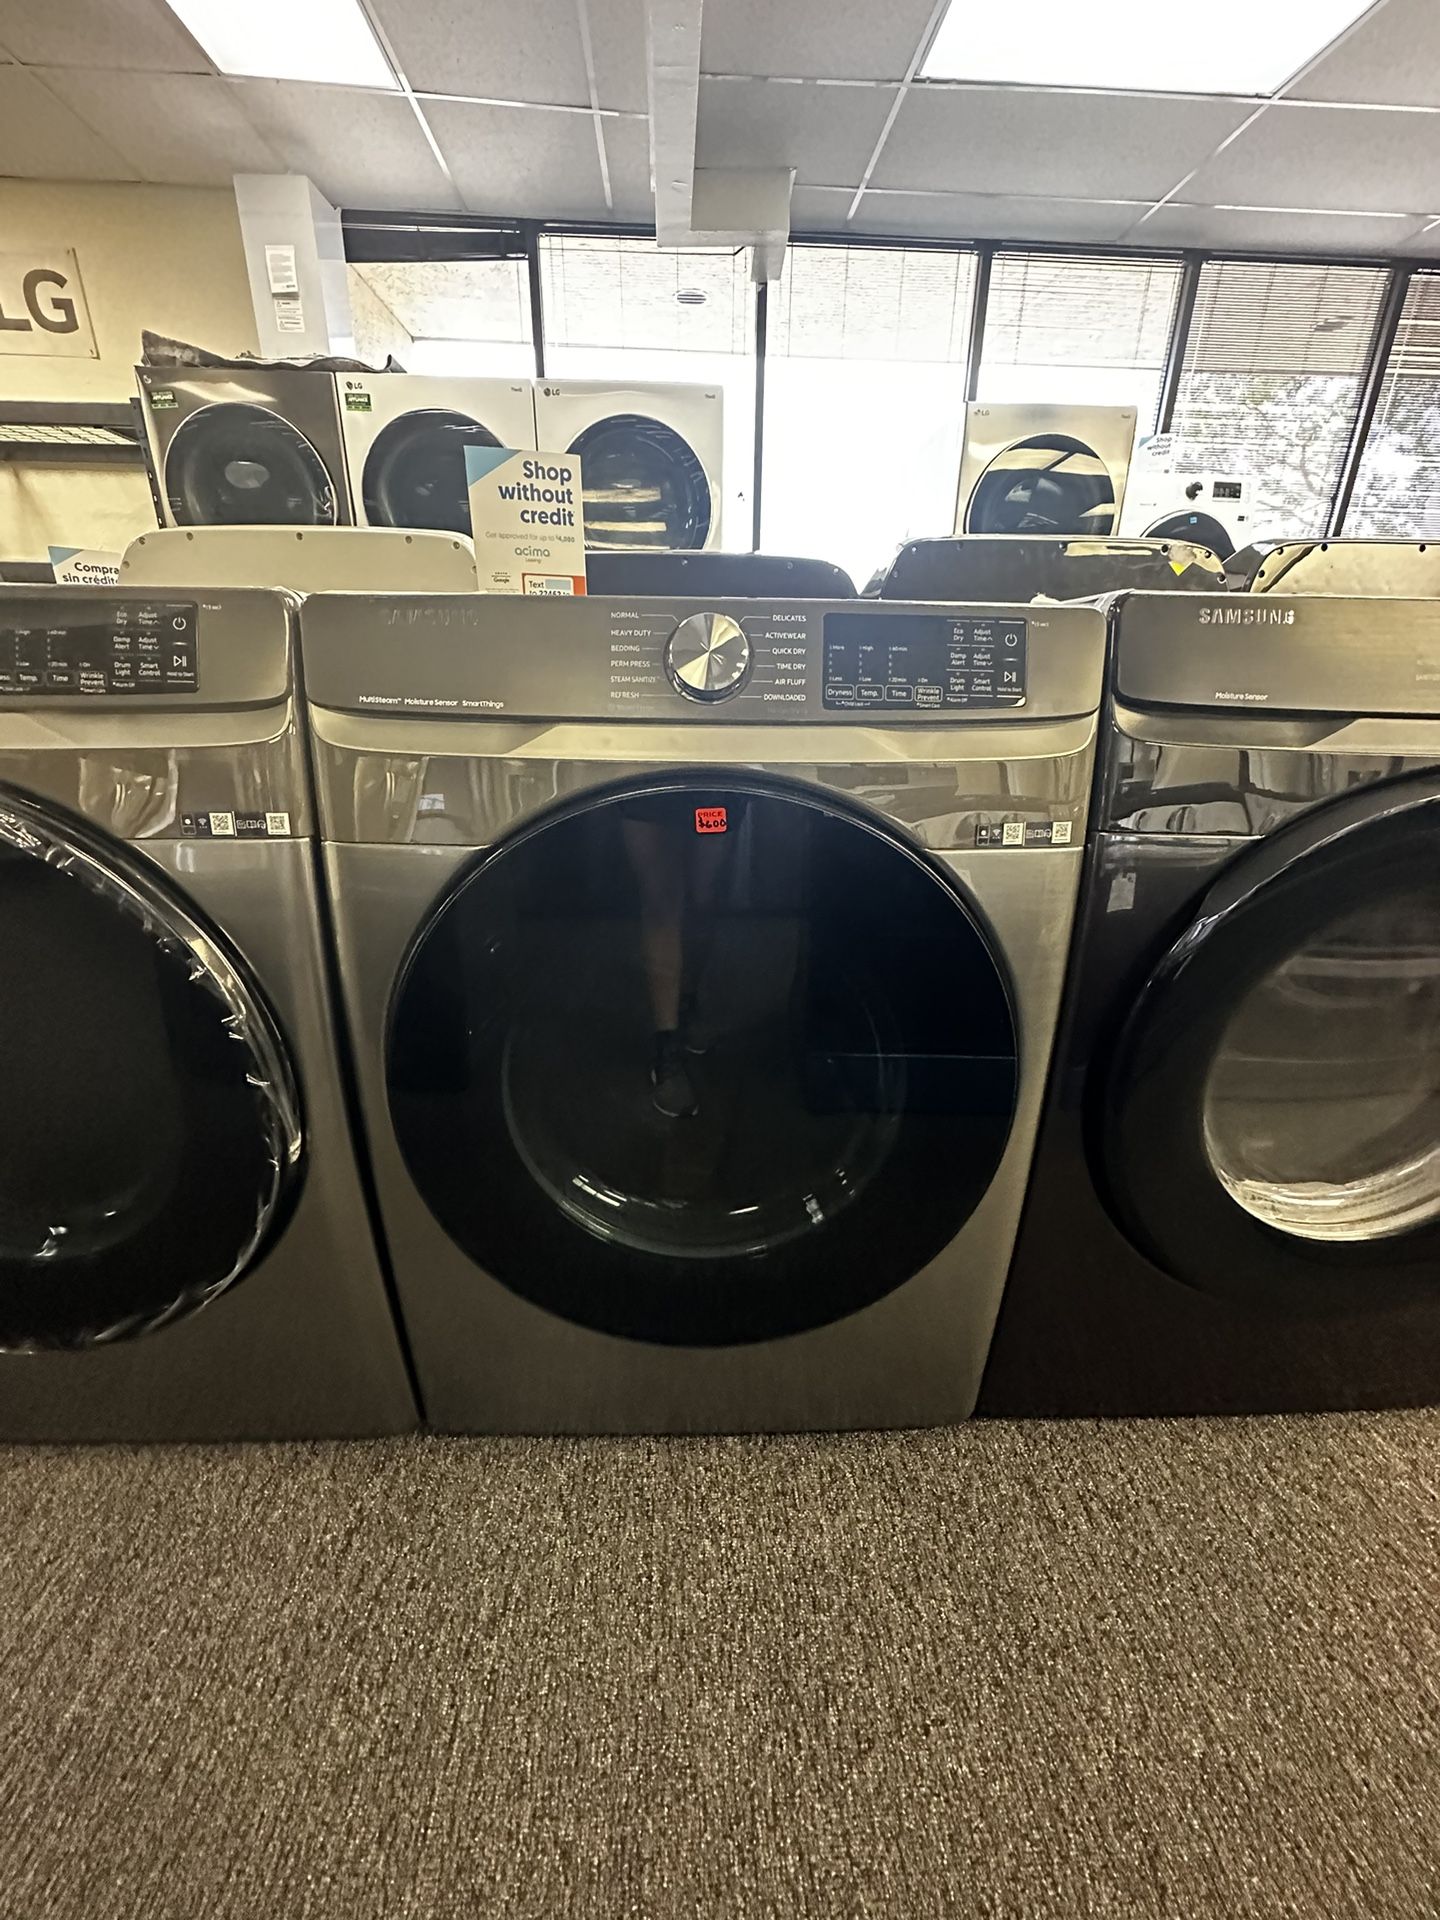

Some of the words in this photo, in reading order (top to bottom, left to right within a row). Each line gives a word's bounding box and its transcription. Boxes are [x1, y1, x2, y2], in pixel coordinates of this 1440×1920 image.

[523, 460, 572, 485] Shop
[498, 482, 573, 504] without
[520, 508, 574, 526] credit
[499, 532, 528, 540] approved
[515, 545, 550, 557] acima
[74, 562, 120, 575] Compra
[62, 572, 80, 583] sin
[529, 580, 544, 589] Text
[1199, 608, 1295, 625] SAMSUNG
[634, 629, 652, 637] DUTY
[772, 647, 792, 655] QUICK
[630, 660, 651, 668] PRESS
[610, 675, 631, 683] STEAM
[787, 678, 807, 686] FLUFF
[828, 688, 853, 697] Dryness
[860, 689, 879, 698] Temp.
[1215, 691, 1244, 700] Moisture
[1245, 693, 1269, 701] Sensor
[404, 697, 434, 706] Moisture
[434, 699, 458, 707] Sensor
[462, 700, 504, 709] SmartThings
